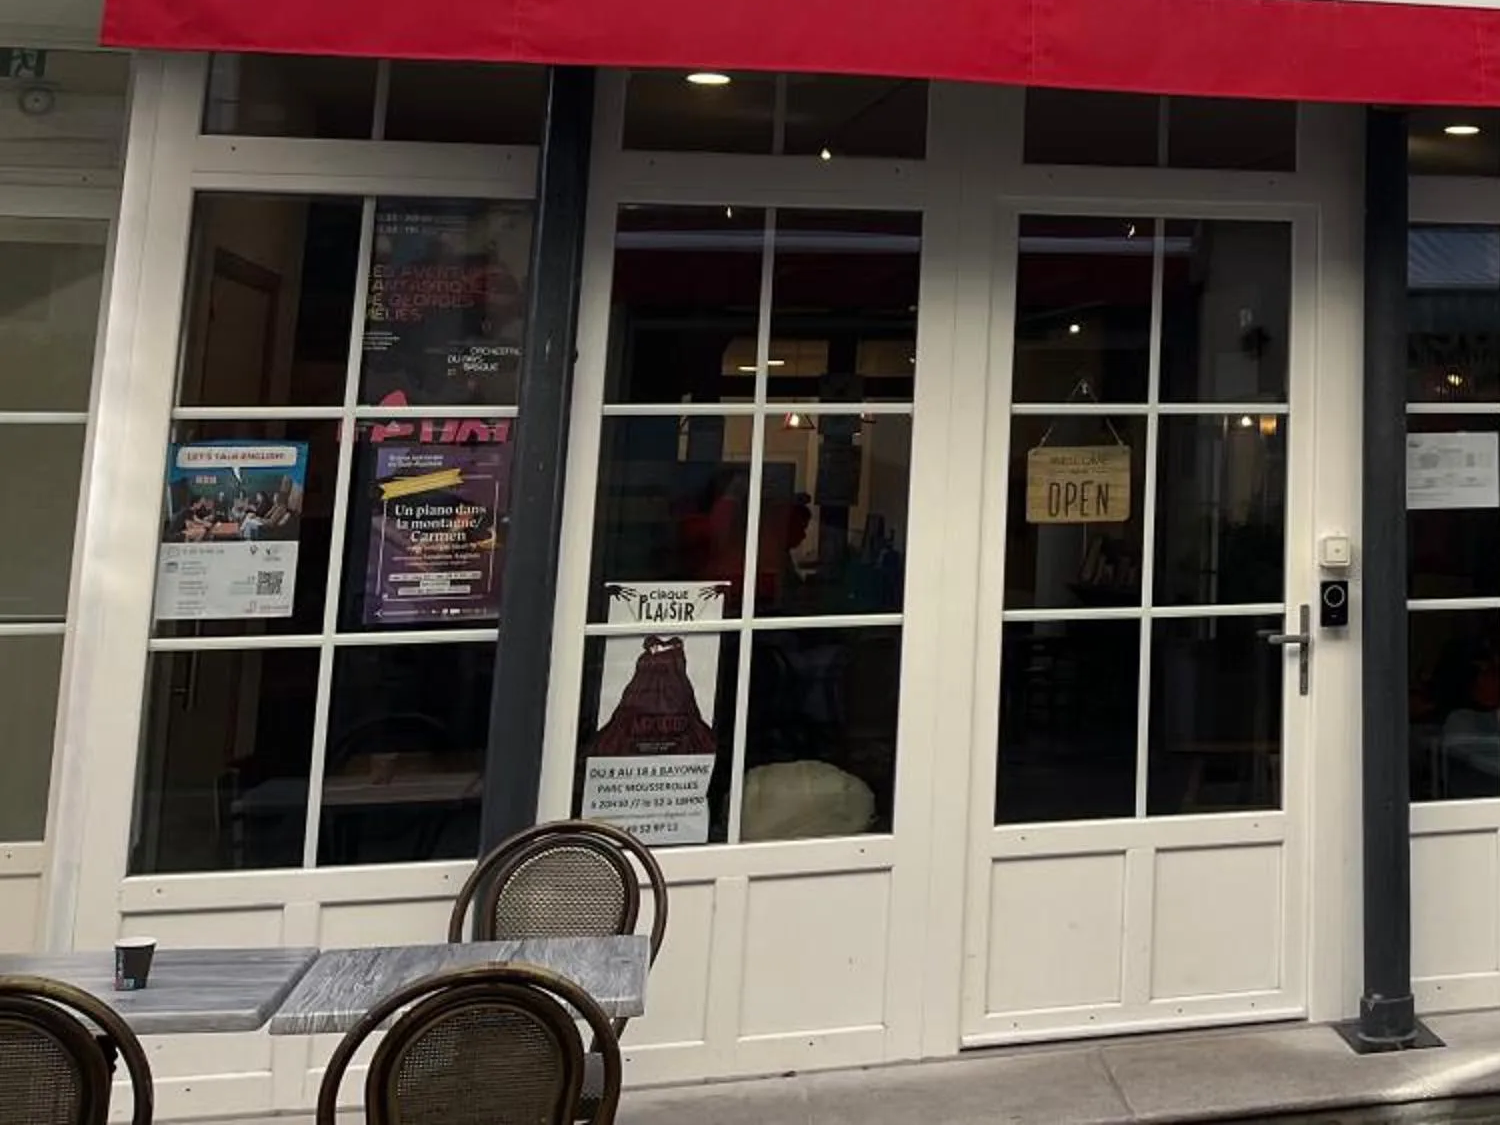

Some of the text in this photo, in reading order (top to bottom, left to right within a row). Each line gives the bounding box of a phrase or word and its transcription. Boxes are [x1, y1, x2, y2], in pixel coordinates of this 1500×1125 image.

[1047, 479, 1110, 518] OPEN
[394, 502, 487, 520] Un piano dans
[396, 518, 409, 530] la
[410, 530, 467, 543] Carmen
[590, 767, 607, 779] DU
[617, 767, 633, 778] AU
[660, 764, 710, 776] BAYONNE
[597, 783, 623, 794] PARC
